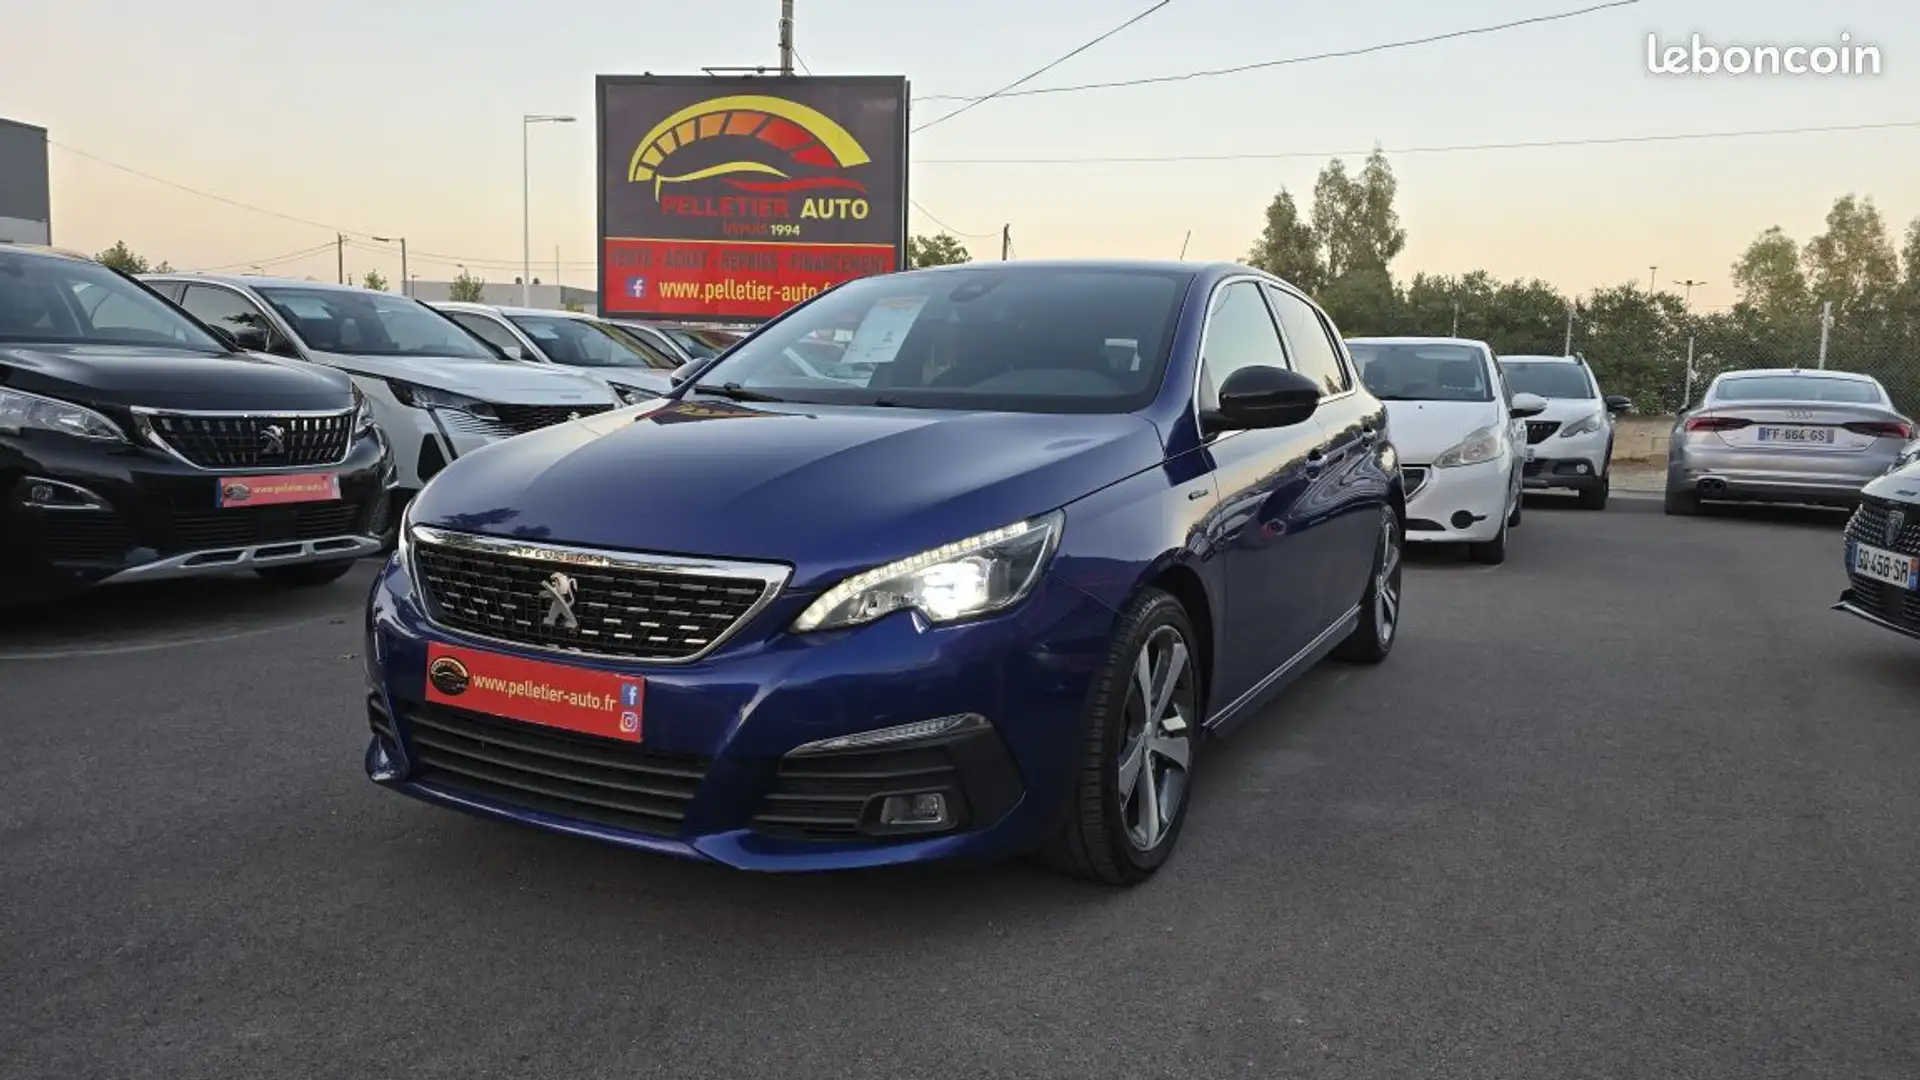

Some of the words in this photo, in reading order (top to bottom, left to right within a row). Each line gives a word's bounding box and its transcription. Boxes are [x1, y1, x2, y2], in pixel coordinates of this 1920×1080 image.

[661, 196, 789, 218] PELLETIER
[800, 198, 869, 220] AUTO
[770, 224, 800, 236] 1994
[721, 250, 778, 271] REPRISE
[791, 253, 887, 274] FINANCEMENT
[473, 673, 617, 712] www.pelletier-auto.fr
